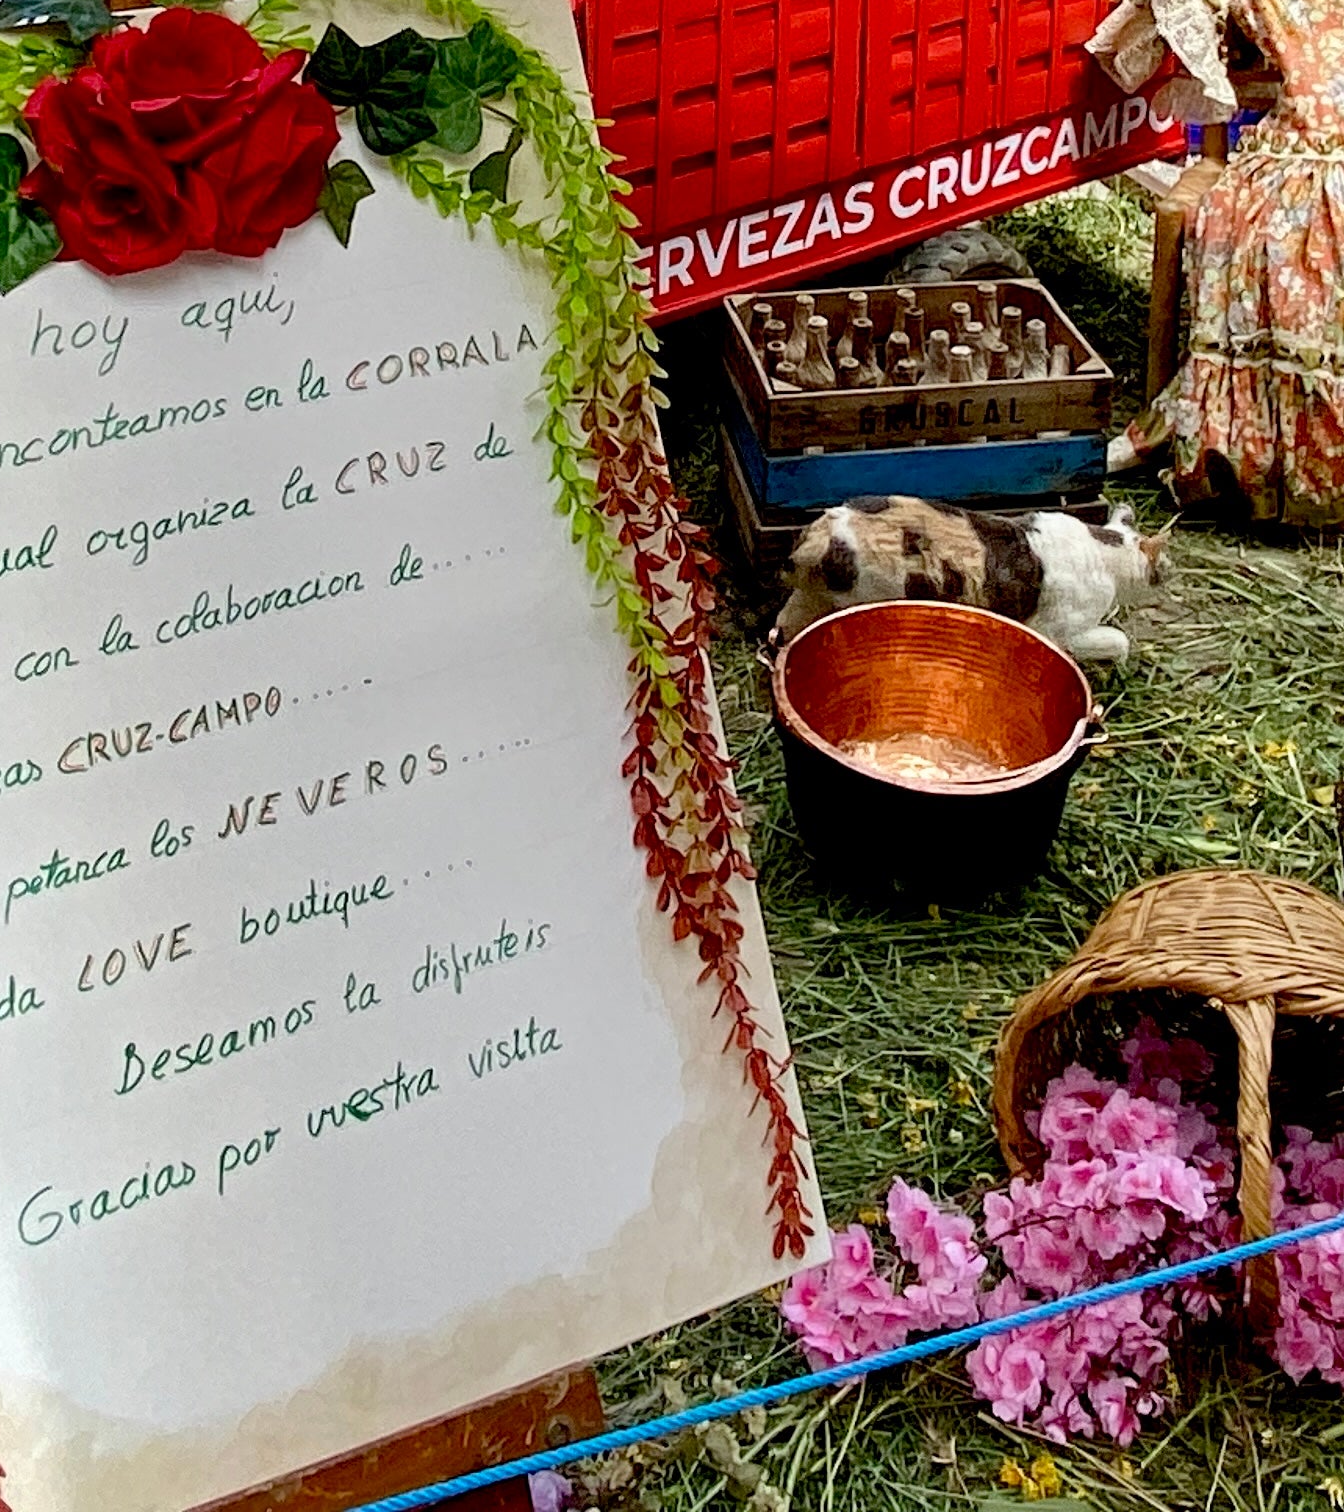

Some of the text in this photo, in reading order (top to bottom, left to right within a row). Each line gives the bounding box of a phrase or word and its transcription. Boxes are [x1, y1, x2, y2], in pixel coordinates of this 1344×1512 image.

[623, 179, 874, 302] ERVEZAS
[31, 308, 128, 376] hoy
[245, 385, 283, 412] en
[298, 358, 330, 402] la
[346, 323, 538, 390] CORRALA
[87, 495, 255, 566] organiza
[282, 466, 318, 510] la
[335, 441, 446, 494] CRUZ
[474, 422, 514, 461] de
[14, 647, 79, 681] con
[98, 614, 140, 655] la
[151, 818, 194, 857] los
[78, 923, 193, 992] LOVE
[114, 998, 317, 1096] Deseamos
[345, 972, 381, 1013] la
[18, 1157, 197, 1246] Gracias
[219, 1126, 281, 1195] por
[308, 1061, 439, 1137] vuestra
